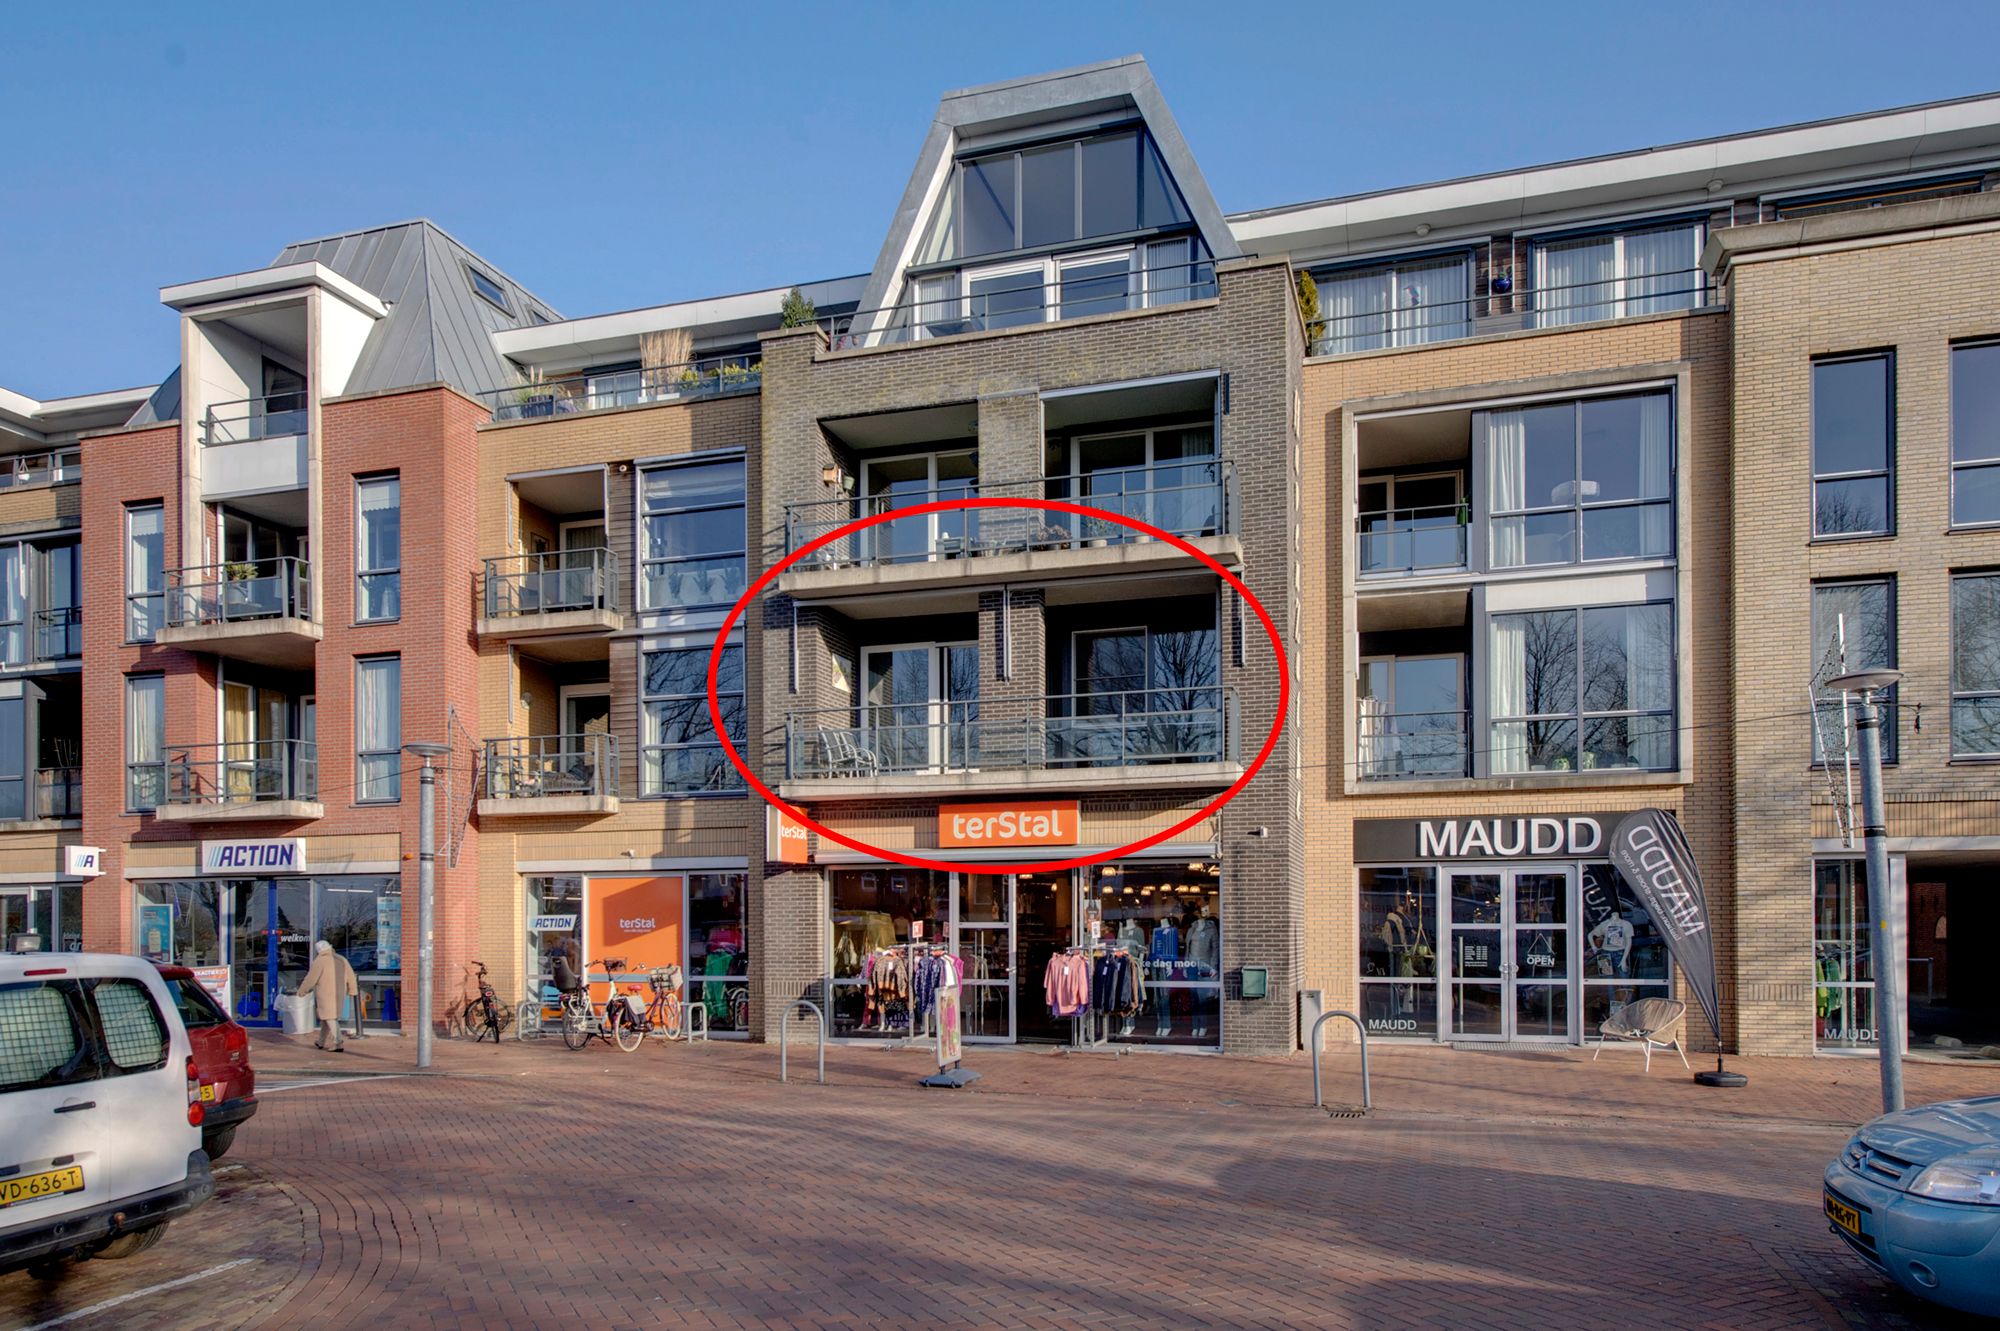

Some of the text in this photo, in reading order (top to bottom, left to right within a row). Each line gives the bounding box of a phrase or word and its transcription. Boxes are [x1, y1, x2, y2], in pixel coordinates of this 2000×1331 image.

[953, 809, 1063, 839] terStal
[781, 825, 807, 840] terStal
[1420, 817, 1602, 857] MAUDD
[219, 844, 294, 867] ACTION
[535, 918, 572, 928] ACTION
[620, 918, 656, 928] terStal
[1153, 959, 1173, 969] dag
[1526, 956, 1555, 966] OPEN
[1369, 1019, 1417, 1030] MAUDD
